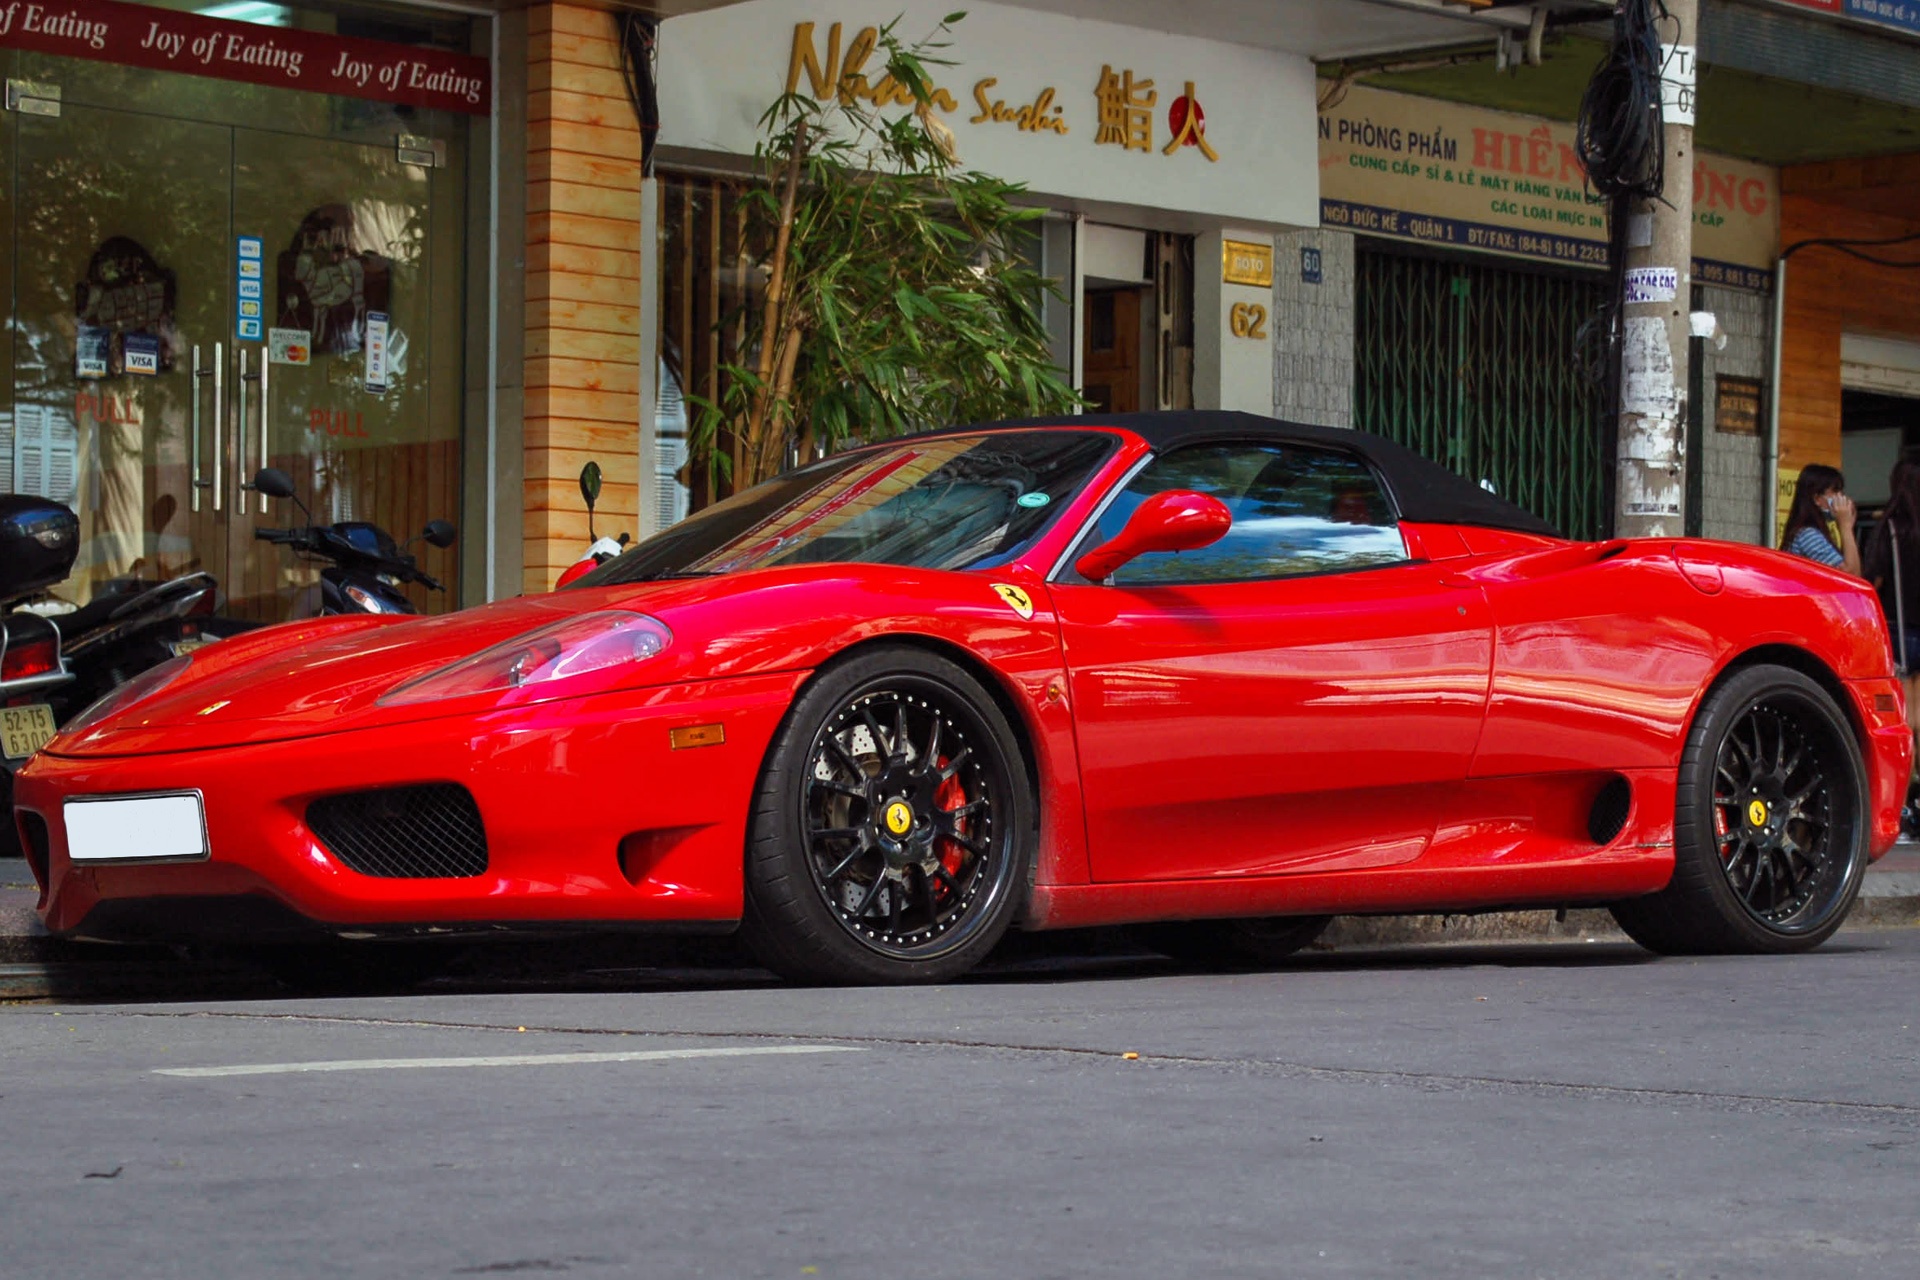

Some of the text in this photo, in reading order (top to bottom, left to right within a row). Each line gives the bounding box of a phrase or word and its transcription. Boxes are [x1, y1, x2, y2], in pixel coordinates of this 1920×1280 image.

[22, 4, 109, 49] Eating
[141, 21, 304, 77] Joy of Eating
[332, 51, 482, 103] Joy of Eating
[970, 77, 1069, 135] Sushi
[1338, 118, 1402, 152] PHÒNG
[1408, 126, 1457, 161] PHẨM
[1349, 153, 1388, 171] CUNG
[1444, 169, 1454, 182] &
[1447, 224, 1454, 240] 1
[1555, 241, 1577, 257] 914
[1303, 252, 1320, 272] 60
[1230, 301, 1267, 339] 62
[83, 361, 103, 371] VISA
[130, 355, 154, 367] VISA
[75, 392, 140, 425] PULL
[309, 408, 369, 439] PULL
